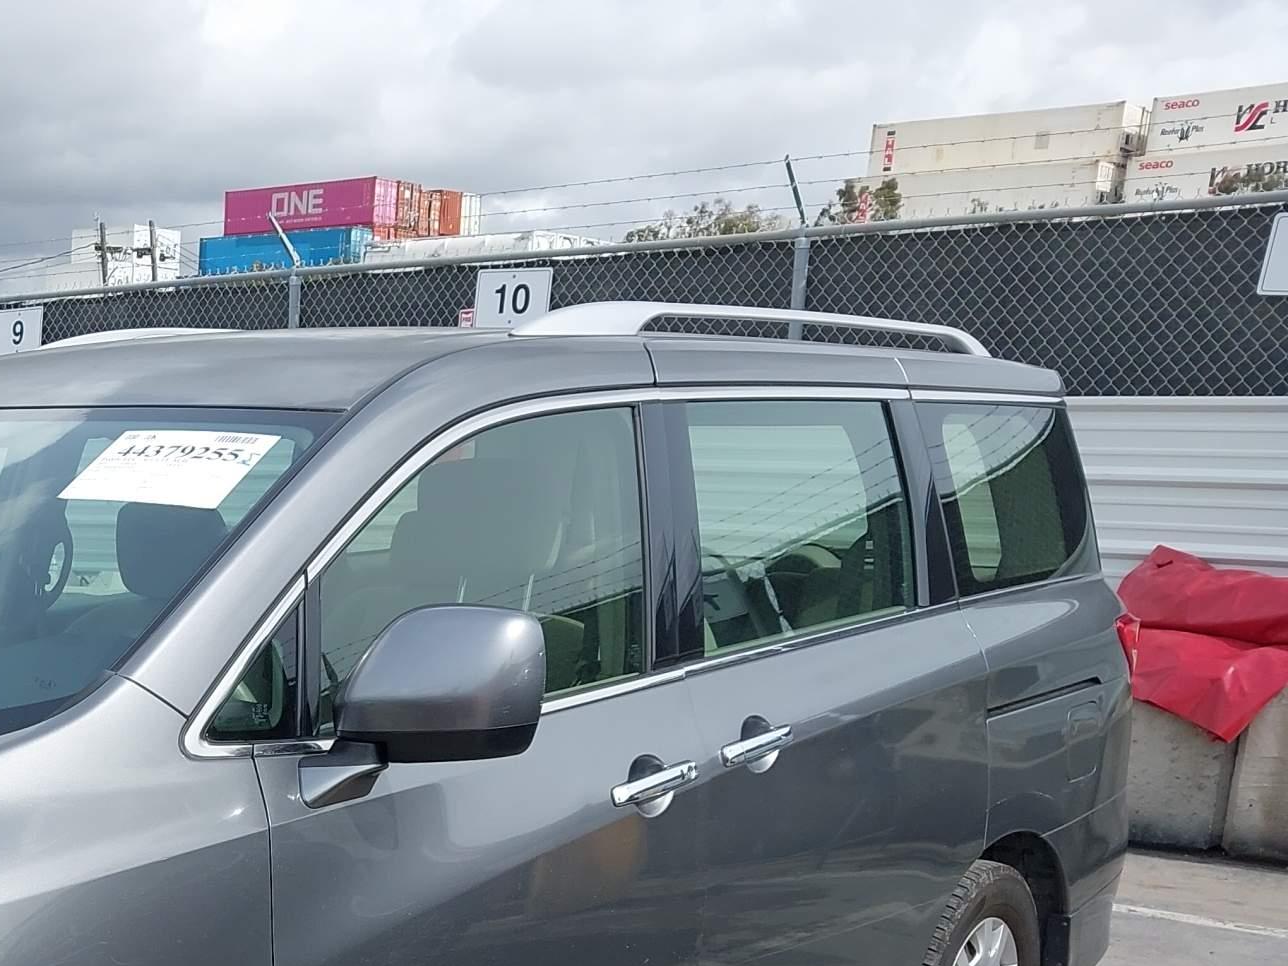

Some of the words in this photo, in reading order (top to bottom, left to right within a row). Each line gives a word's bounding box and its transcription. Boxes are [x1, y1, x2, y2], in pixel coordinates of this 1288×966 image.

[1163, 99, 1200, 111] seaco
[1137, 160, 1174, 171] seaco
[271, 188, 324, 217] ONE
[494, 283, 530, 314] 10
[12, 320, 24, 345] 9
[117, 444, 245, 462] 44379255
